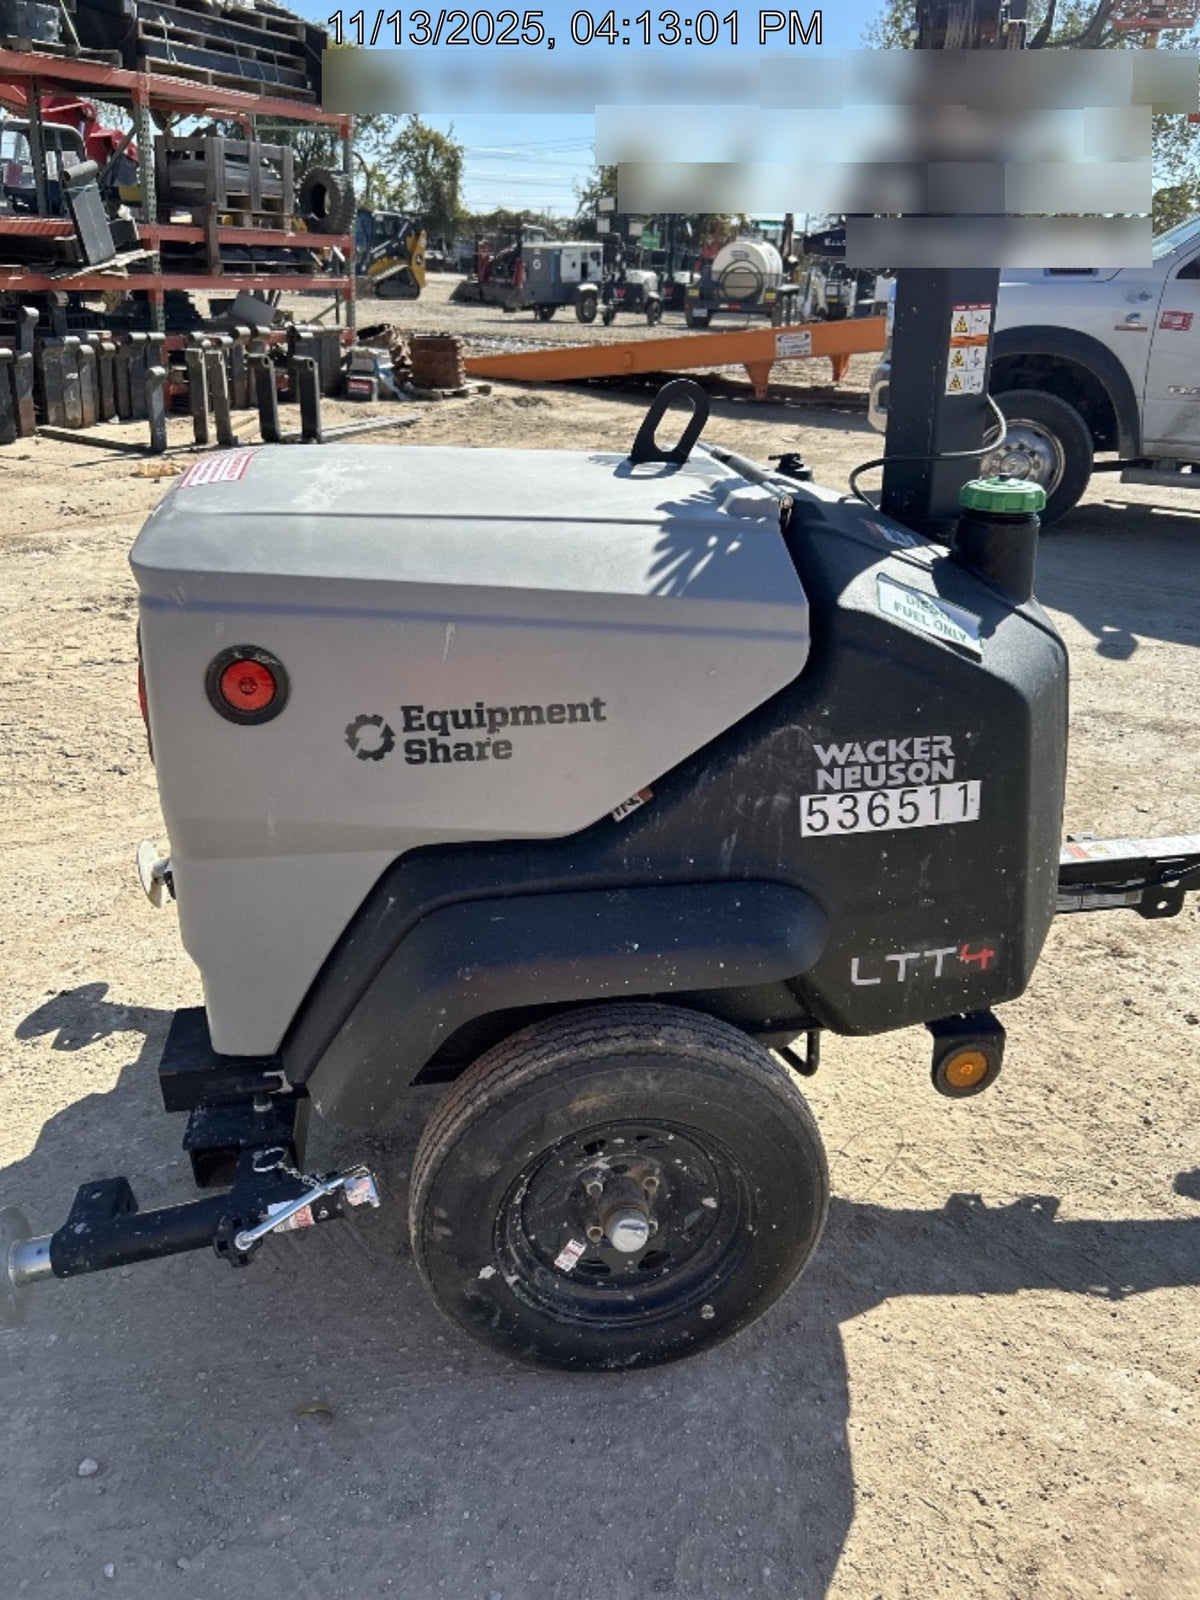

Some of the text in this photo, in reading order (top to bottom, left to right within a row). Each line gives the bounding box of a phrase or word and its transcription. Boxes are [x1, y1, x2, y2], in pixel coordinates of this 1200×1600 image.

[893, 600, 967, 643] FUEL ONLY
[401, 696, 607, 737] Equipment
[403, 737, 513, 766] Share
[812, 735, 956, 767] WACKER
[815, 758, 956, 791] NEUSON
[805, 782, 970, 833] 536511
[851, 943, 995, 986] LTT4
